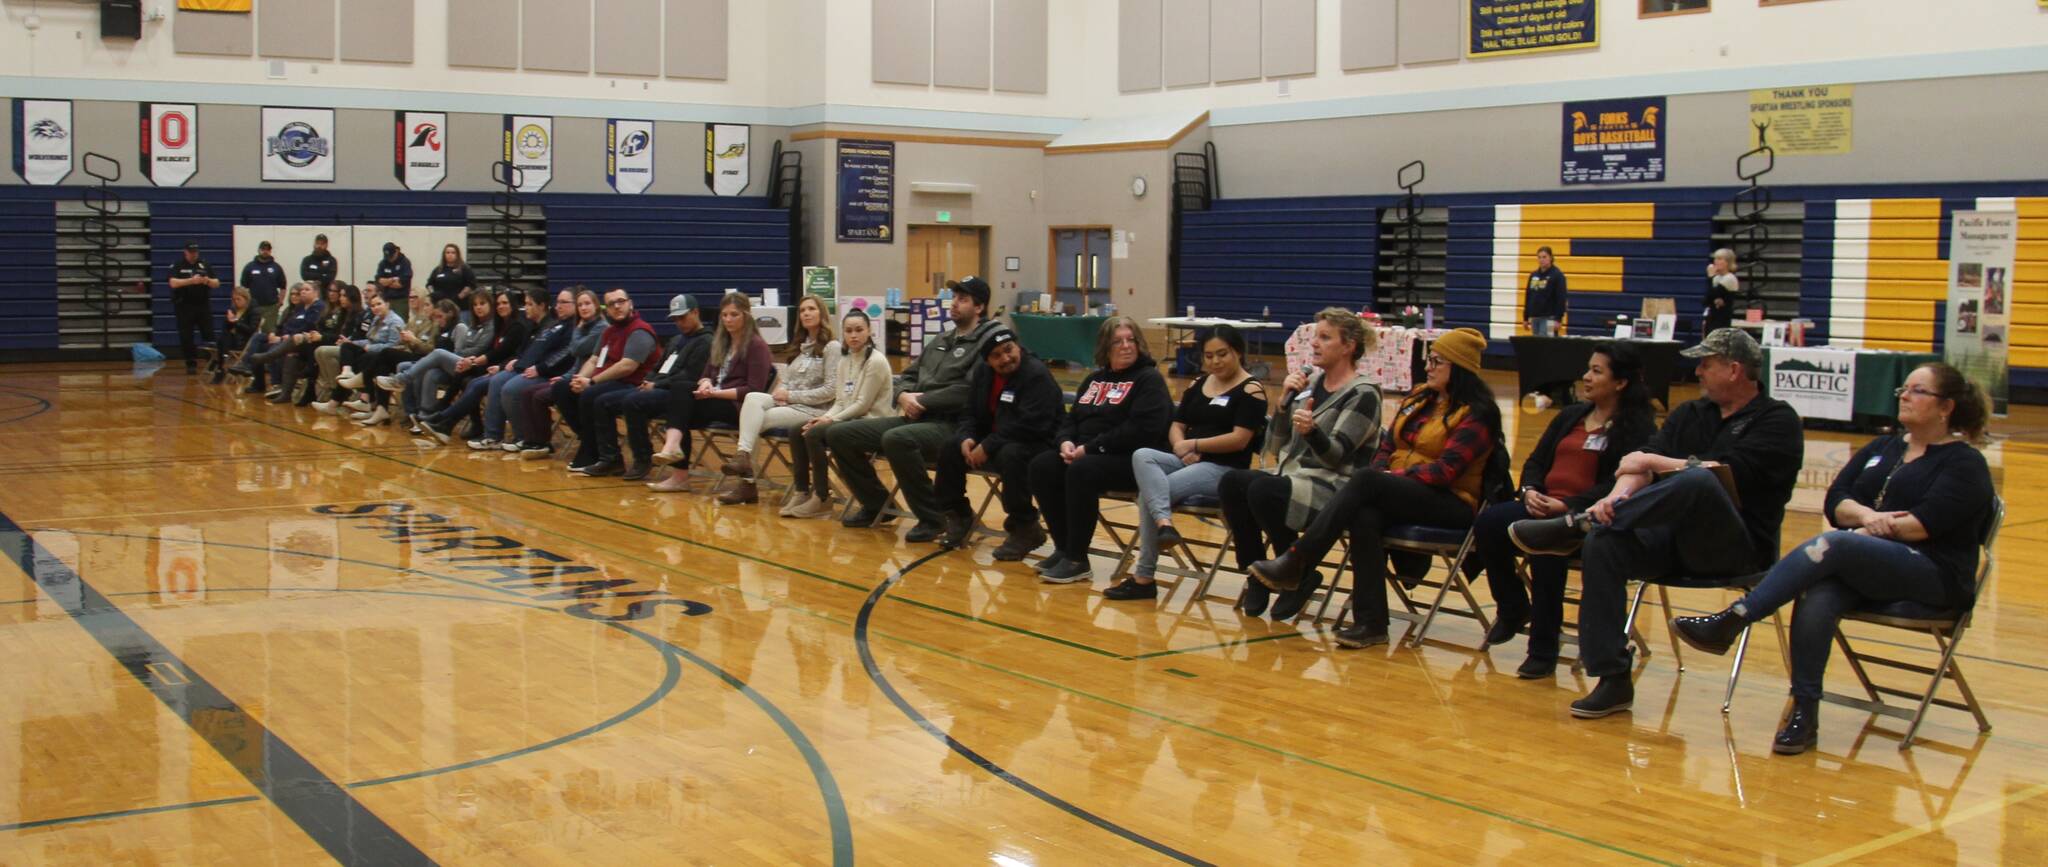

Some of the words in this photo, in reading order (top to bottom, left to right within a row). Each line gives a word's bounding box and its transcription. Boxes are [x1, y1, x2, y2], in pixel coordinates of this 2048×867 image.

[1501, 38, 1516, 47] THE
[1517, 36, 1537, 46] BLUE
[1539, 34, 1555, 43] AND
[1772, 89, 1804, 99] THANK
[1808, 87, 1828, 97] YOU
[158, 111, 189, 149] O
[1574, 132, 1597, 145] BOYS
[1600, 129, 1655, 144] BASKETBALL
[1775, 372, 1848, 392] PACIFIC
[312, 503, 713, 621] SPARTANS
